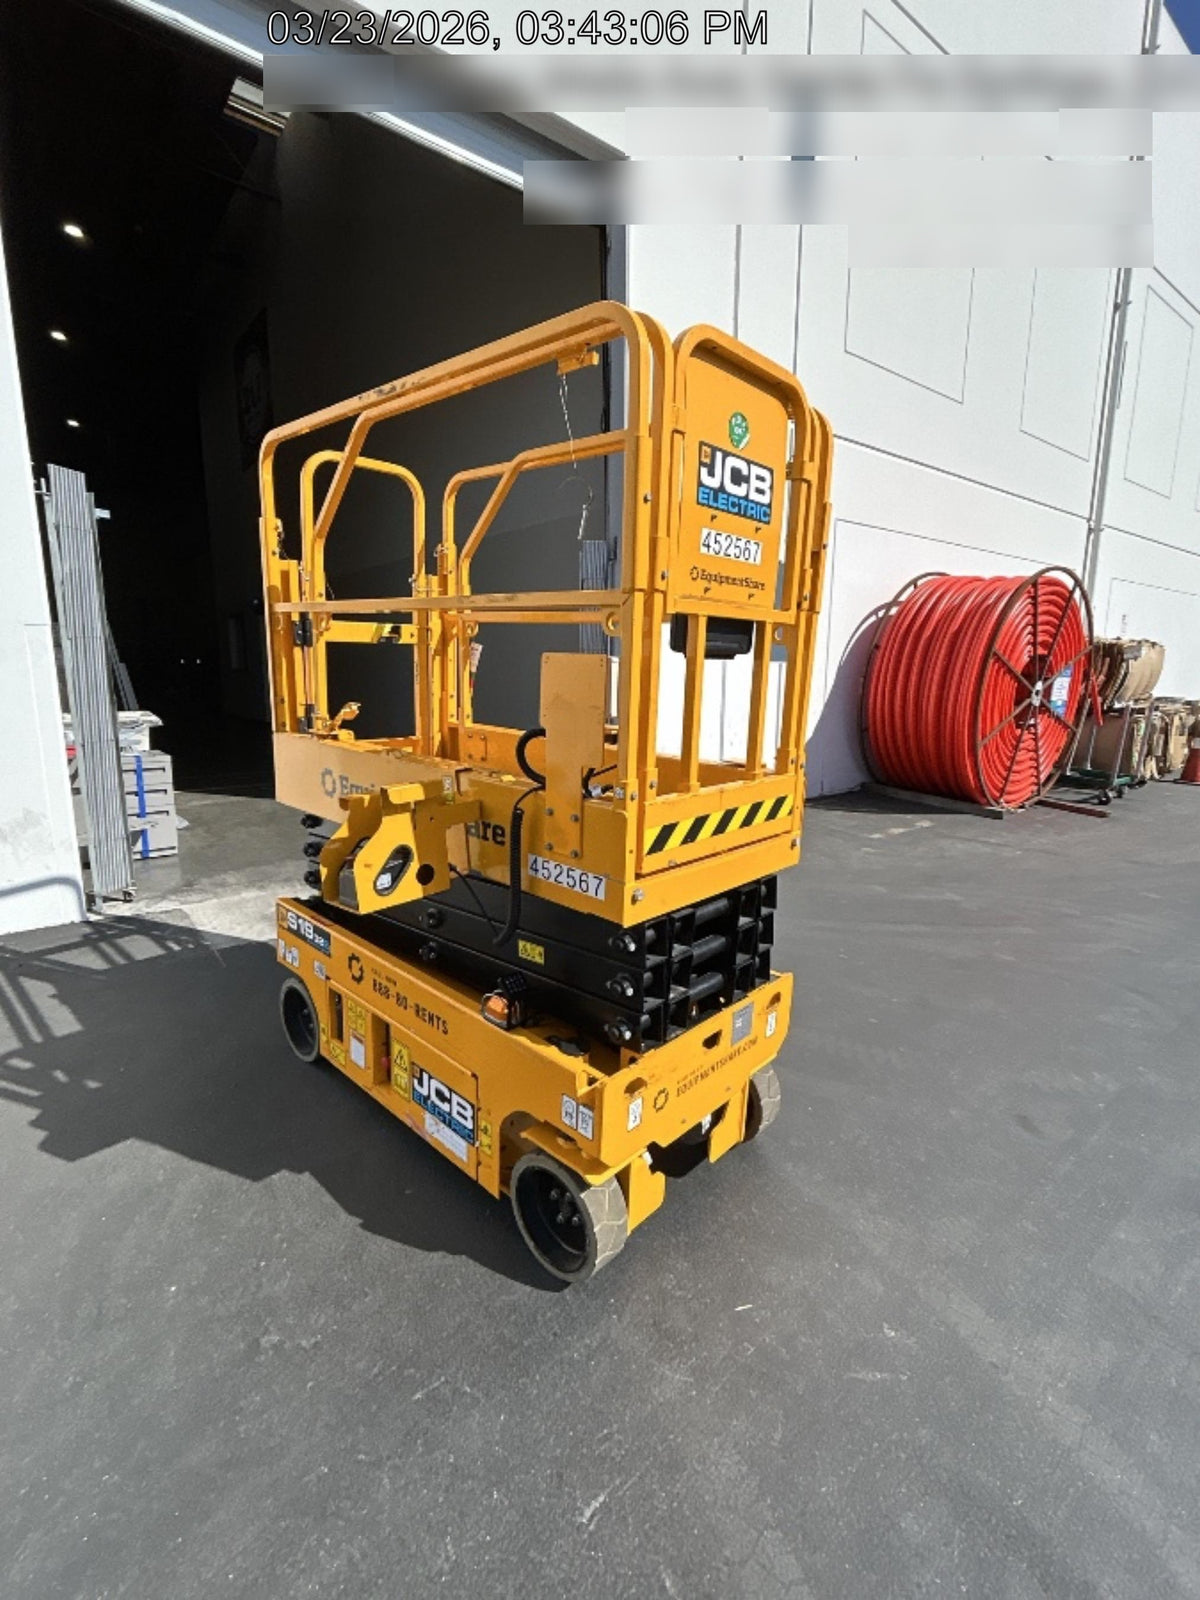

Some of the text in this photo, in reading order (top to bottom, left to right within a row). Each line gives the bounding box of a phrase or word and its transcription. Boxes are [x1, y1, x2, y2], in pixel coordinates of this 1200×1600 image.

[700, 450, 772, 505] JCB
[698, 486, 771, 522] ELECTRIC
[702, 530, 760, 563] 452567
[529, 856, 604, 897] 452567
[413, 1071, 474, 1130] JCB
[413, 1090, 474, 1143] ELECTRIC
